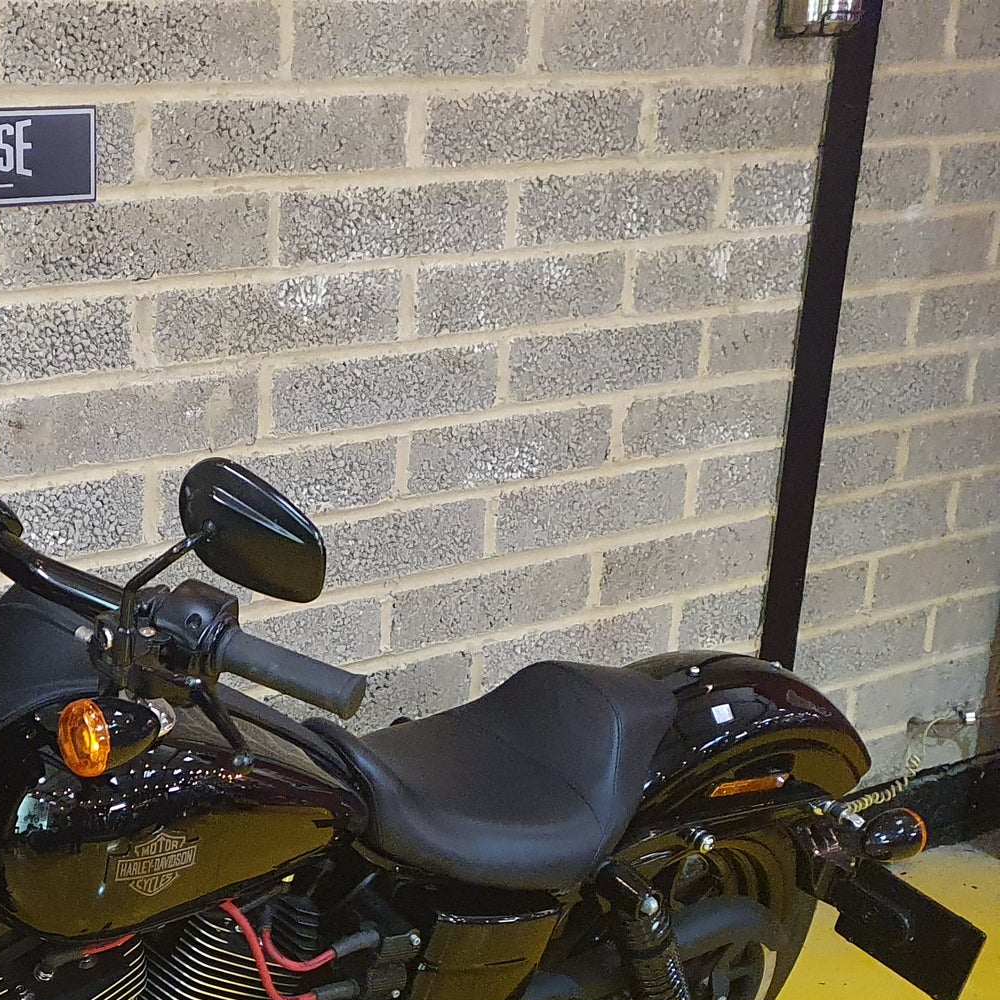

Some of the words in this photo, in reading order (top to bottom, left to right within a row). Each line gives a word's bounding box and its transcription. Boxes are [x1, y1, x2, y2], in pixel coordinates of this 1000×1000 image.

[141, 836, 178, 857] MOTOR
[119, 848, 194, 877] HARLEY-DAVIDSON
[135, 872, 173, 893] CYCLES
